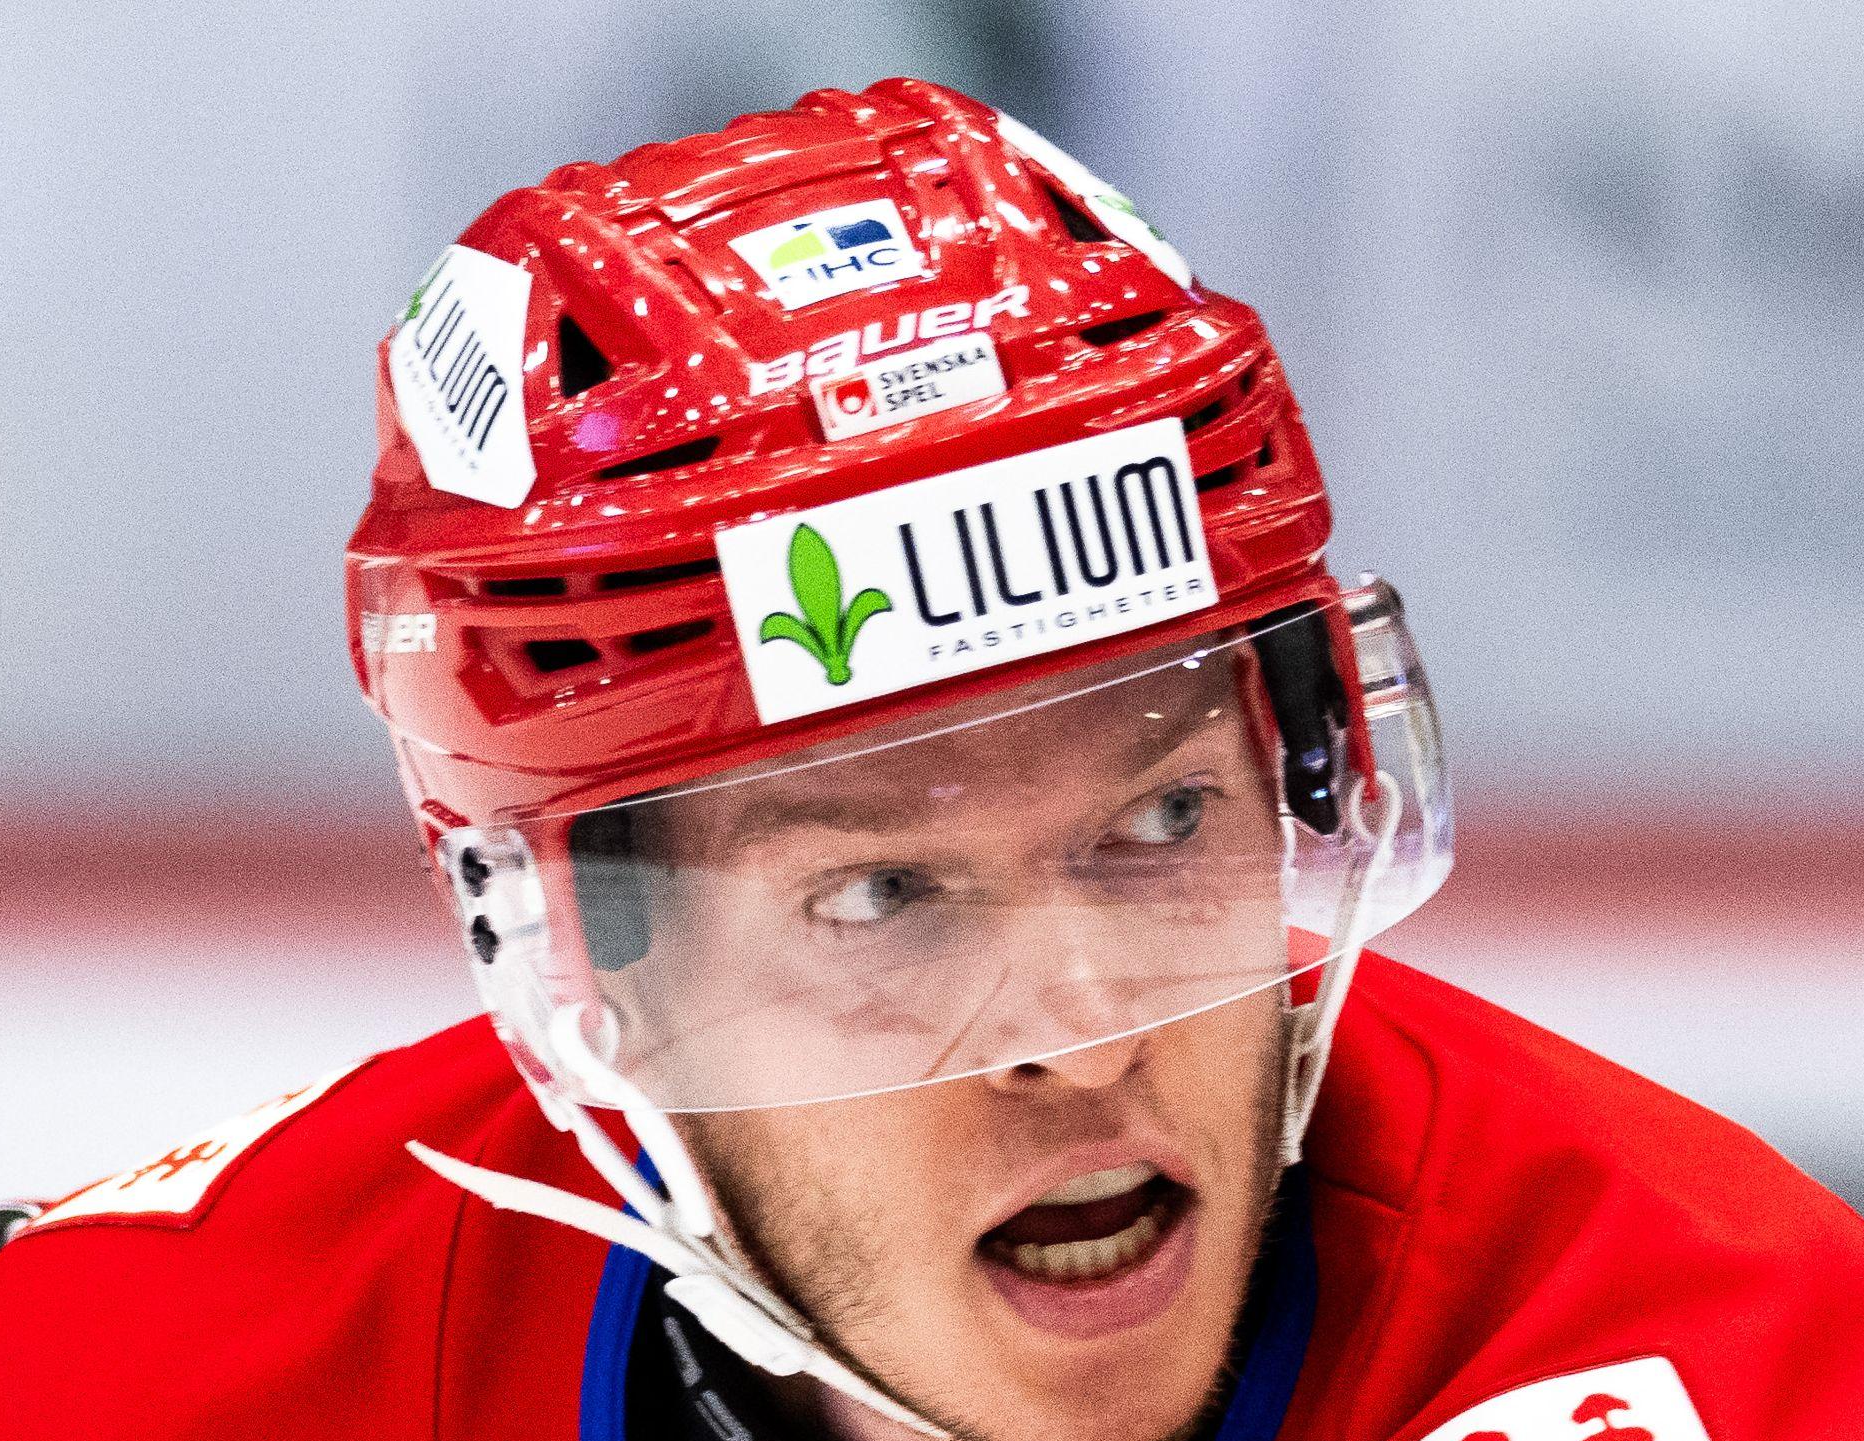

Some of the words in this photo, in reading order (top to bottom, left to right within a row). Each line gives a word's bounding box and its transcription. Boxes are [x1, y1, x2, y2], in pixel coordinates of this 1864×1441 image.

[412, 277, 509, 452] LILIUM
[876, 346, 994, 388] SVENSKA
[885, 381, 946, 412] SPEL
[898, 455, 1196, 628] LILIUM
[928, 577, 1204, 660] FASTIGHETER
